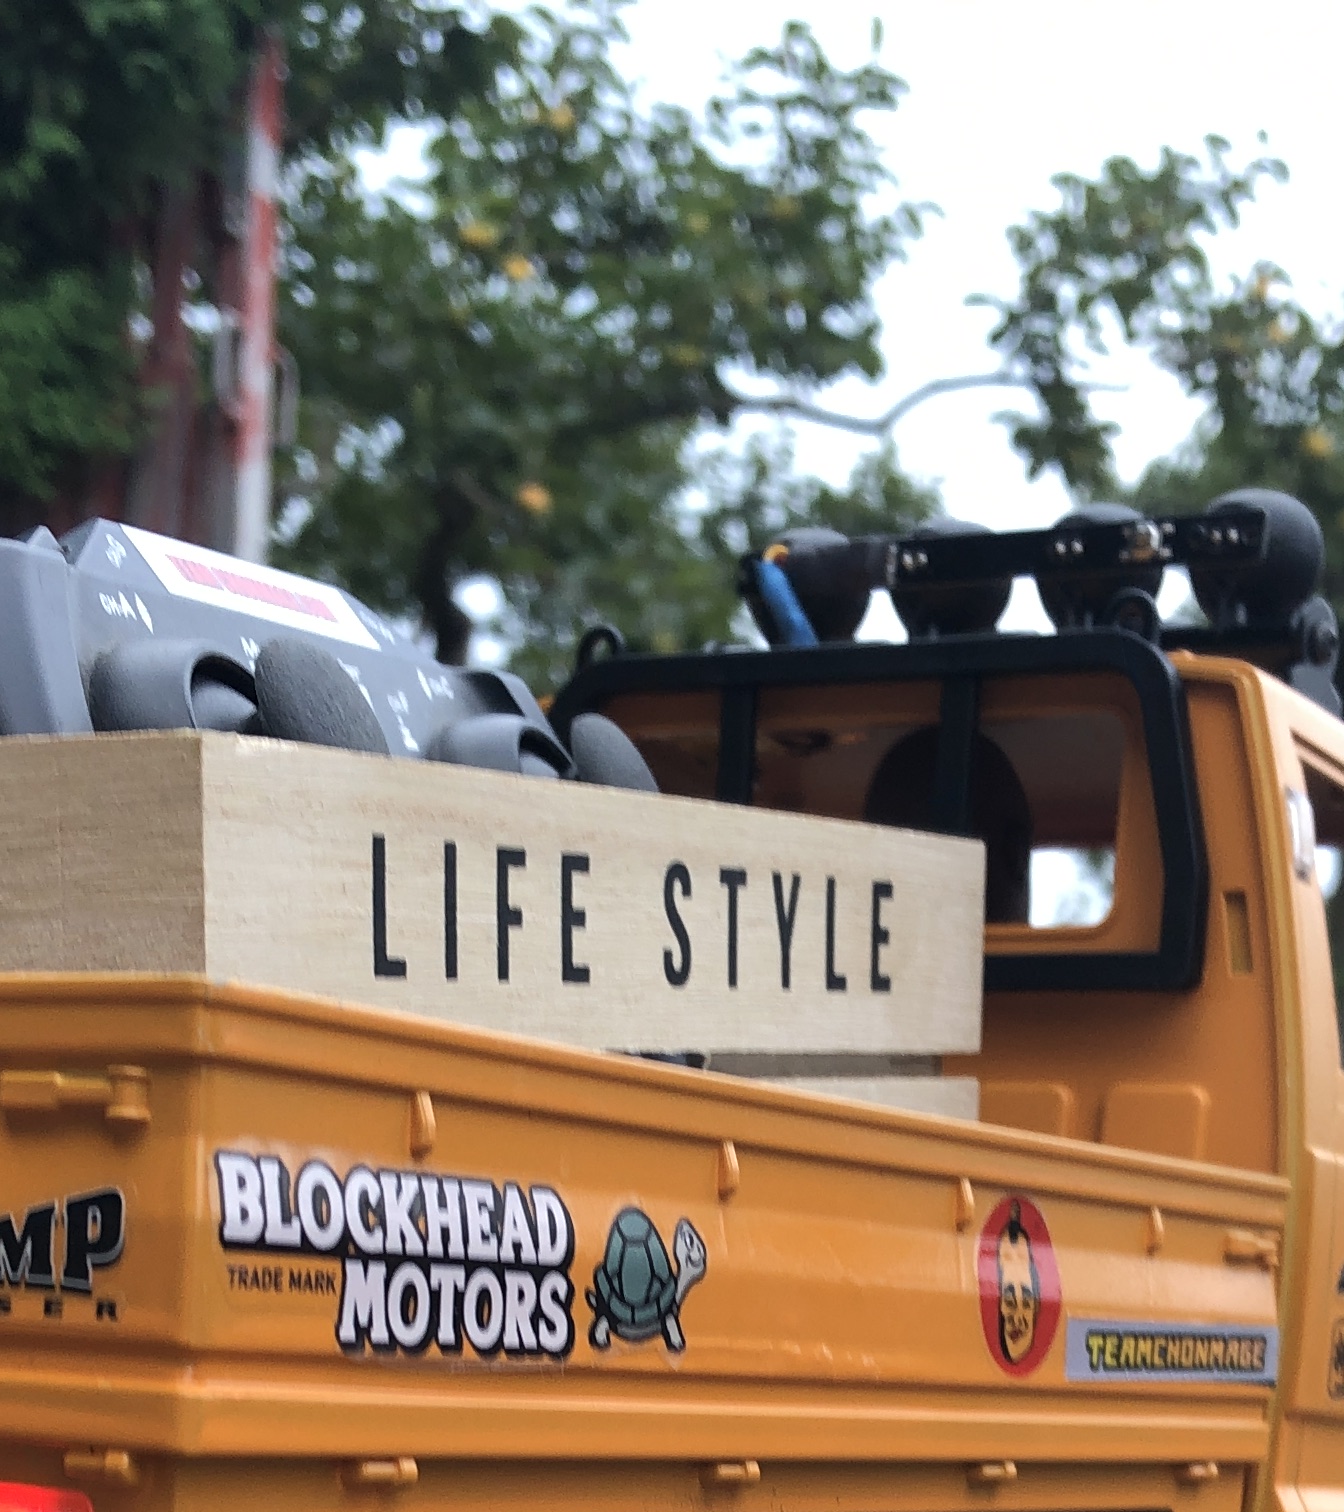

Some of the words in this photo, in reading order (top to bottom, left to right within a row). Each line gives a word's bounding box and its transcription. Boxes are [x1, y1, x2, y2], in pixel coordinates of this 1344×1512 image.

[371, 832, 591, 984] LIFE
[662, 860, 894, 993] STYLE
[215, 1151, 572, 1269] BLOCKHEAD
[227, 1263, 284, 1293] TRADE
[288, 1265, 337, 1297] MARK
[337, 1257, 572, 1356] MOTORS
